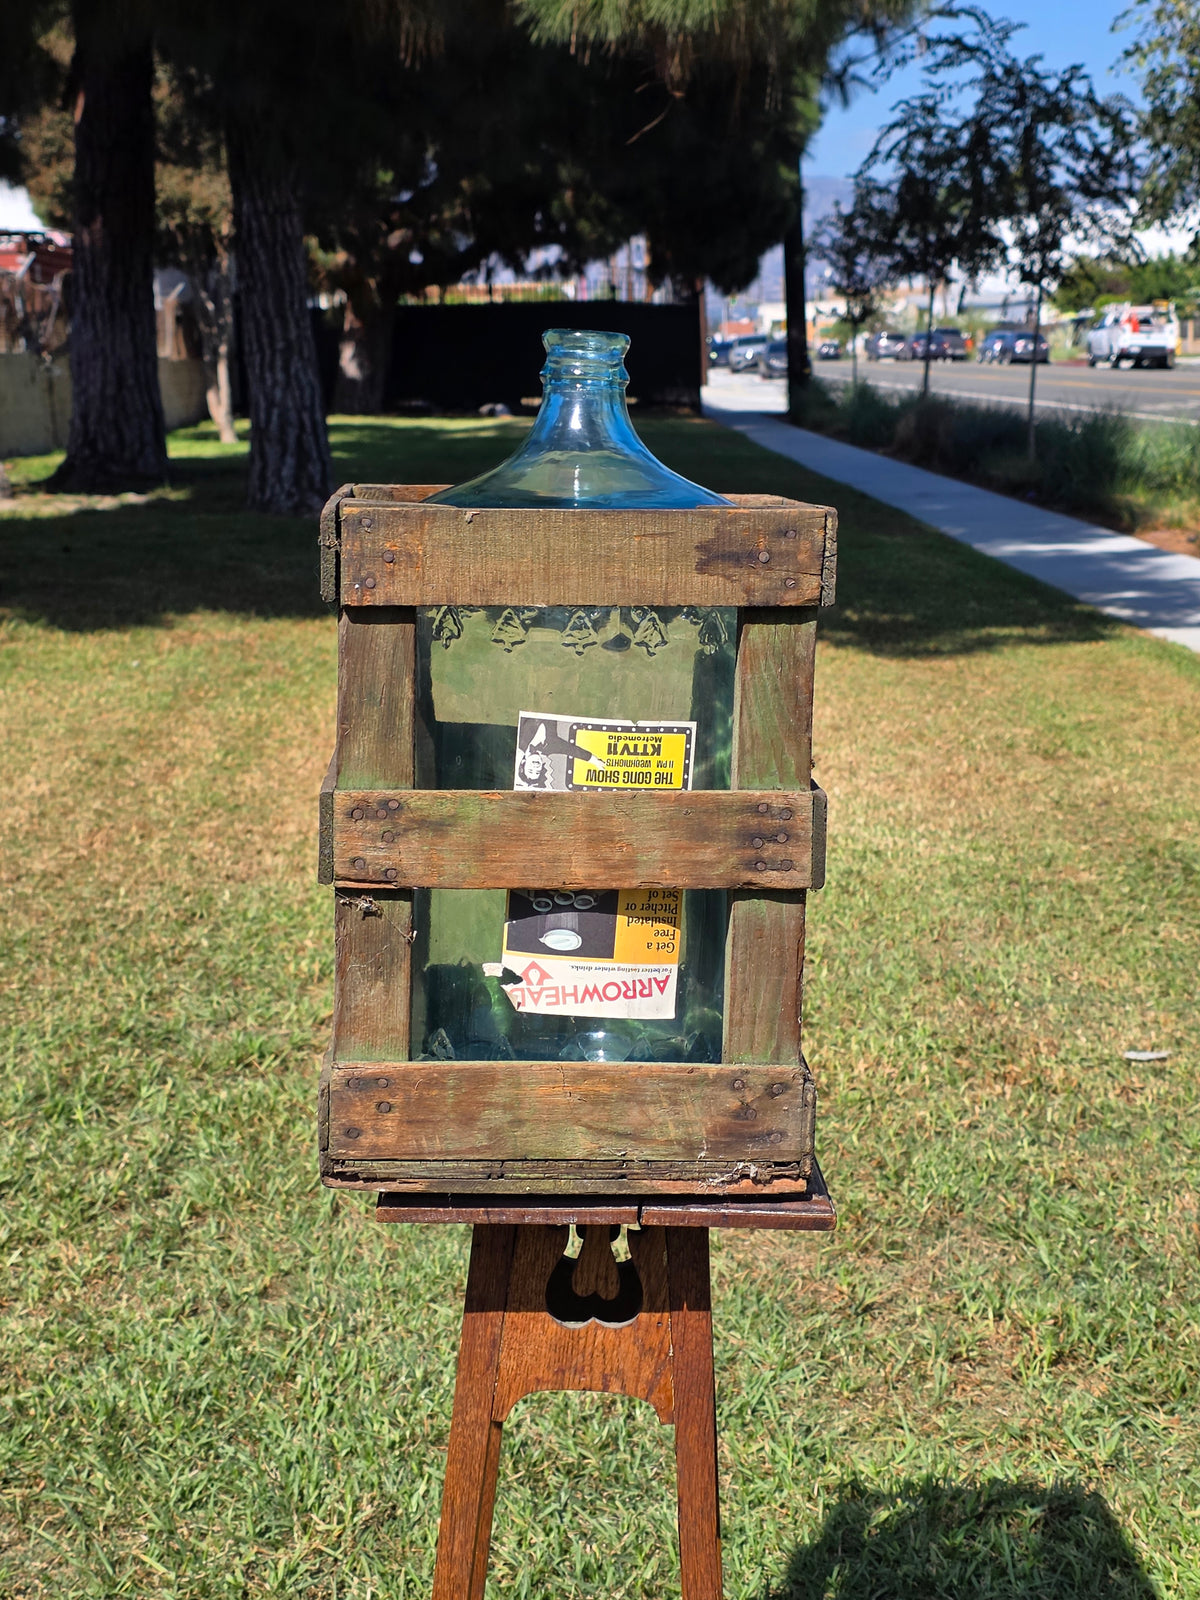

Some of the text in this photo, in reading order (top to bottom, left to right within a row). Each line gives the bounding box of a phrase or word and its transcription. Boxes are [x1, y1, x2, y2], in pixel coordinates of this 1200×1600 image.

[608, 735, 662, 743] Metromedia
[656, 760, 668, 768] PM
[586, 769, 620, 783] SHOW
[648, 890, 679, 902] Set of
[624, 903, 678, 914] Pitcher or
[627, 916, 677, 928] Insulated
[653, 929, 676, 940] Free
[646, 942, 675, 953] Get a
